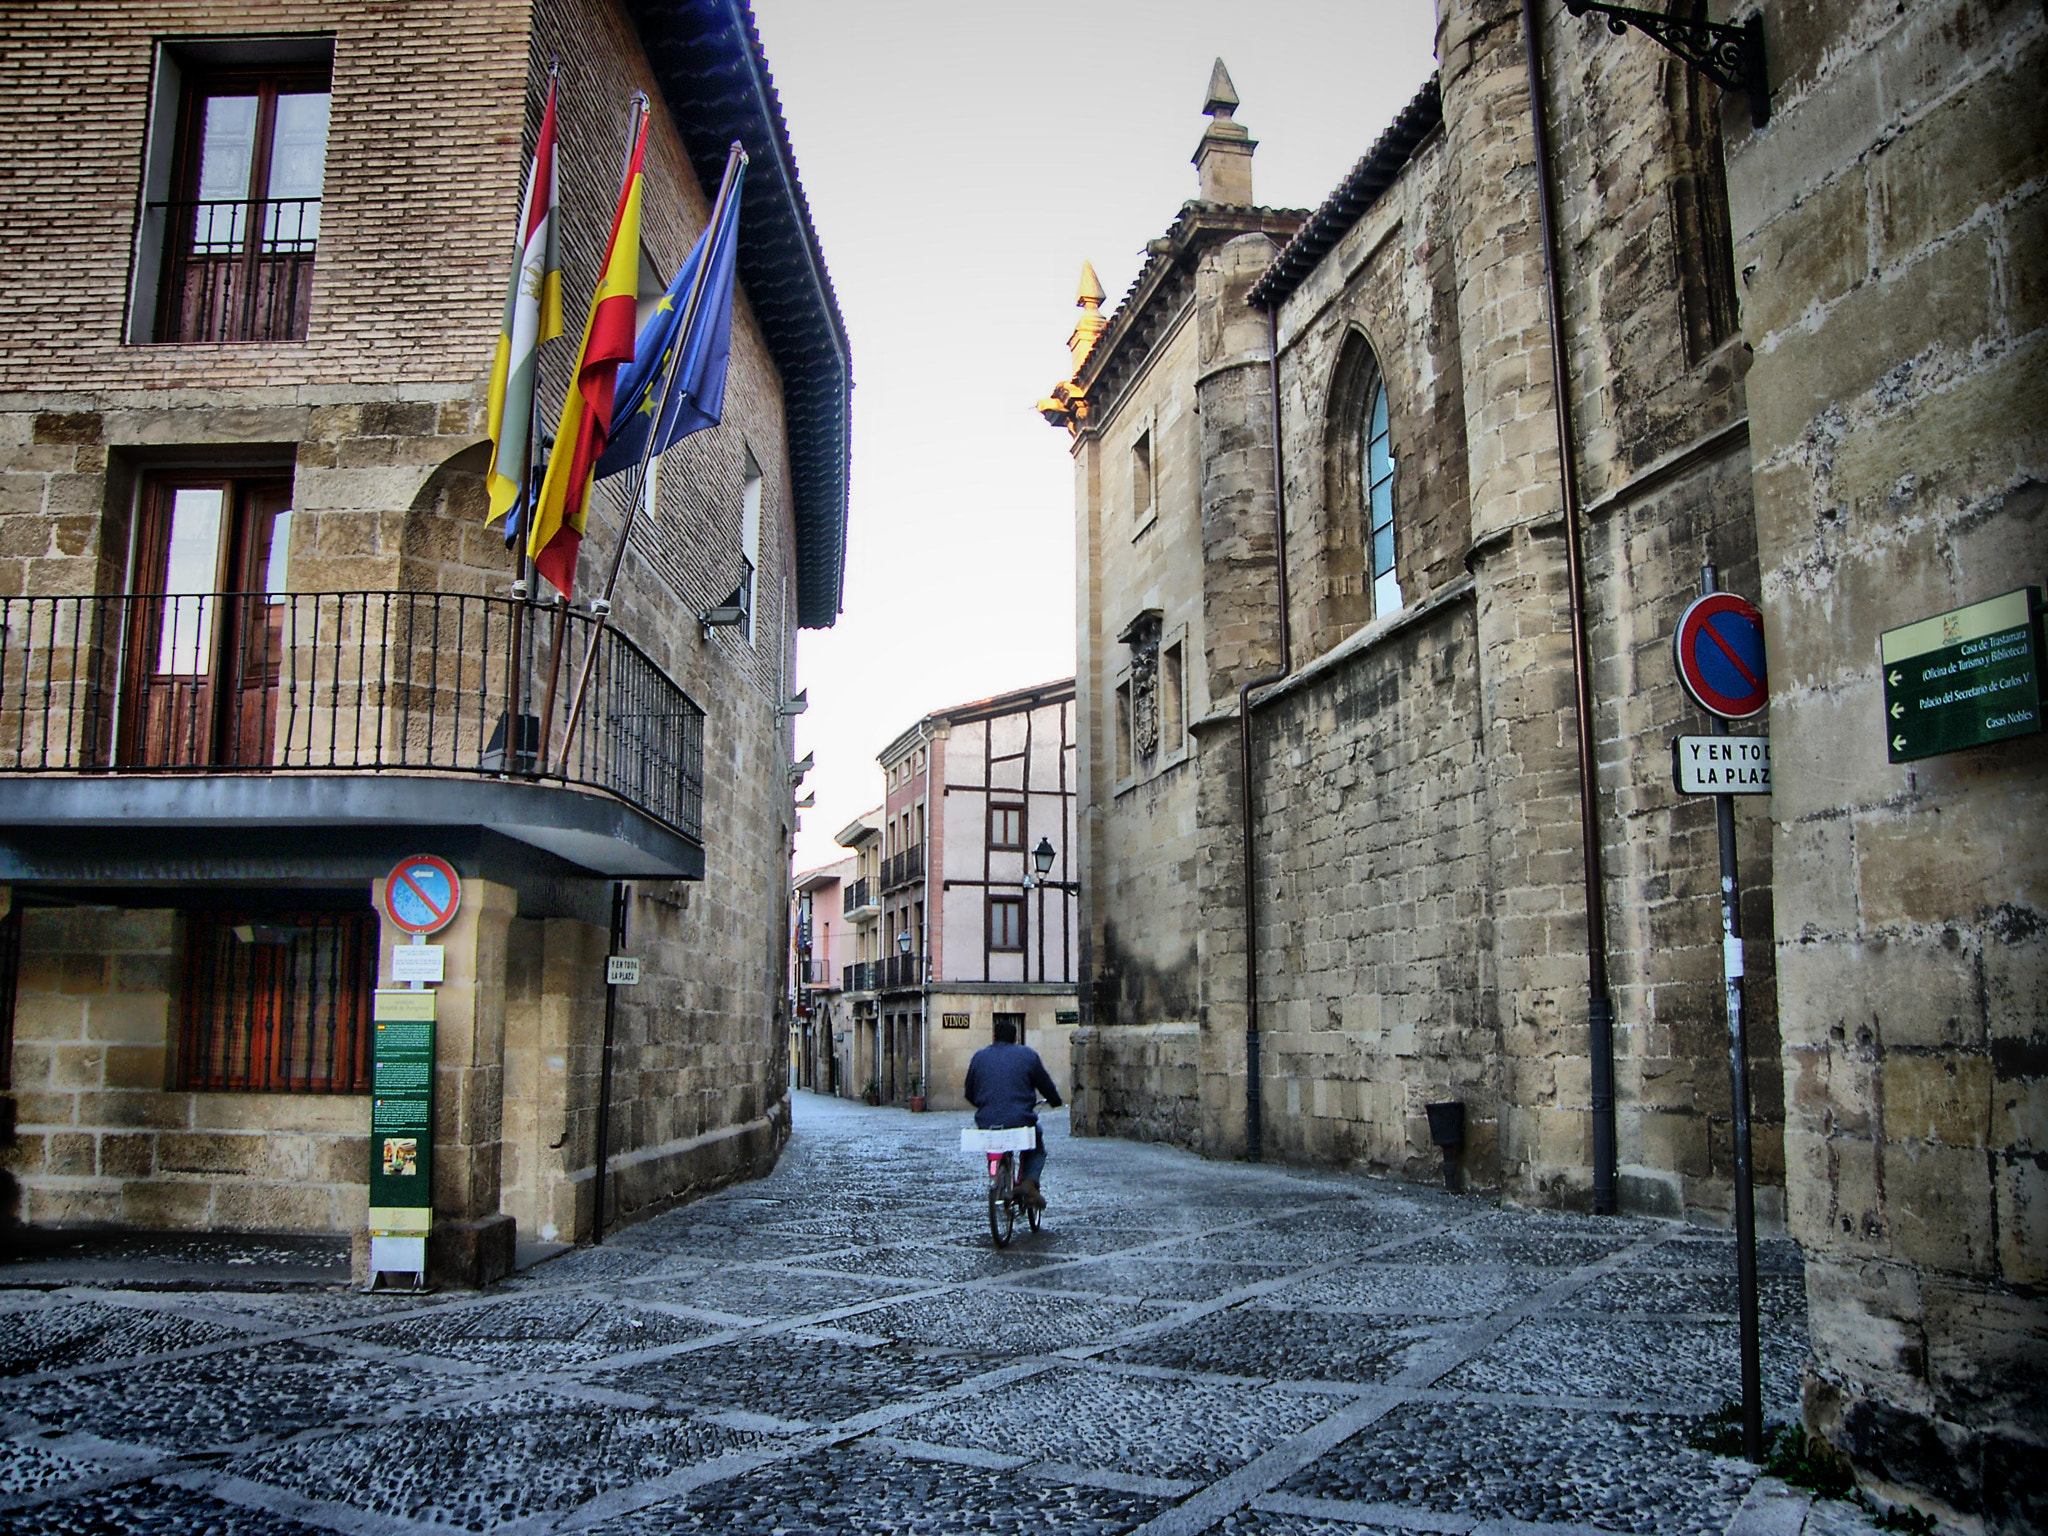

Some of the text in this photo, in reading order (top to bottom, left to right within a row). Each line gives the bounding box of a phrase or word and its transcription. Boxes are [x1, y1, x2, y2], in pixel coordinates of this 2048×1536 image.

[1961, 631, 2027, 656] Casa de Trastamara
[1922, 643, 2028, 682] (Oficina de Turismo y Biblioteca)
[1919, 671, 2030, 709] Palacio del Secretario de Carlos V
[1985, 709, 2033, 729] Casas Nobles
[1690, 744, 1771, 760] Y EN TOD
[1697, 768, 1771, 784] LA PLAZ
[943, 1015, 969, 1027] VINOS
